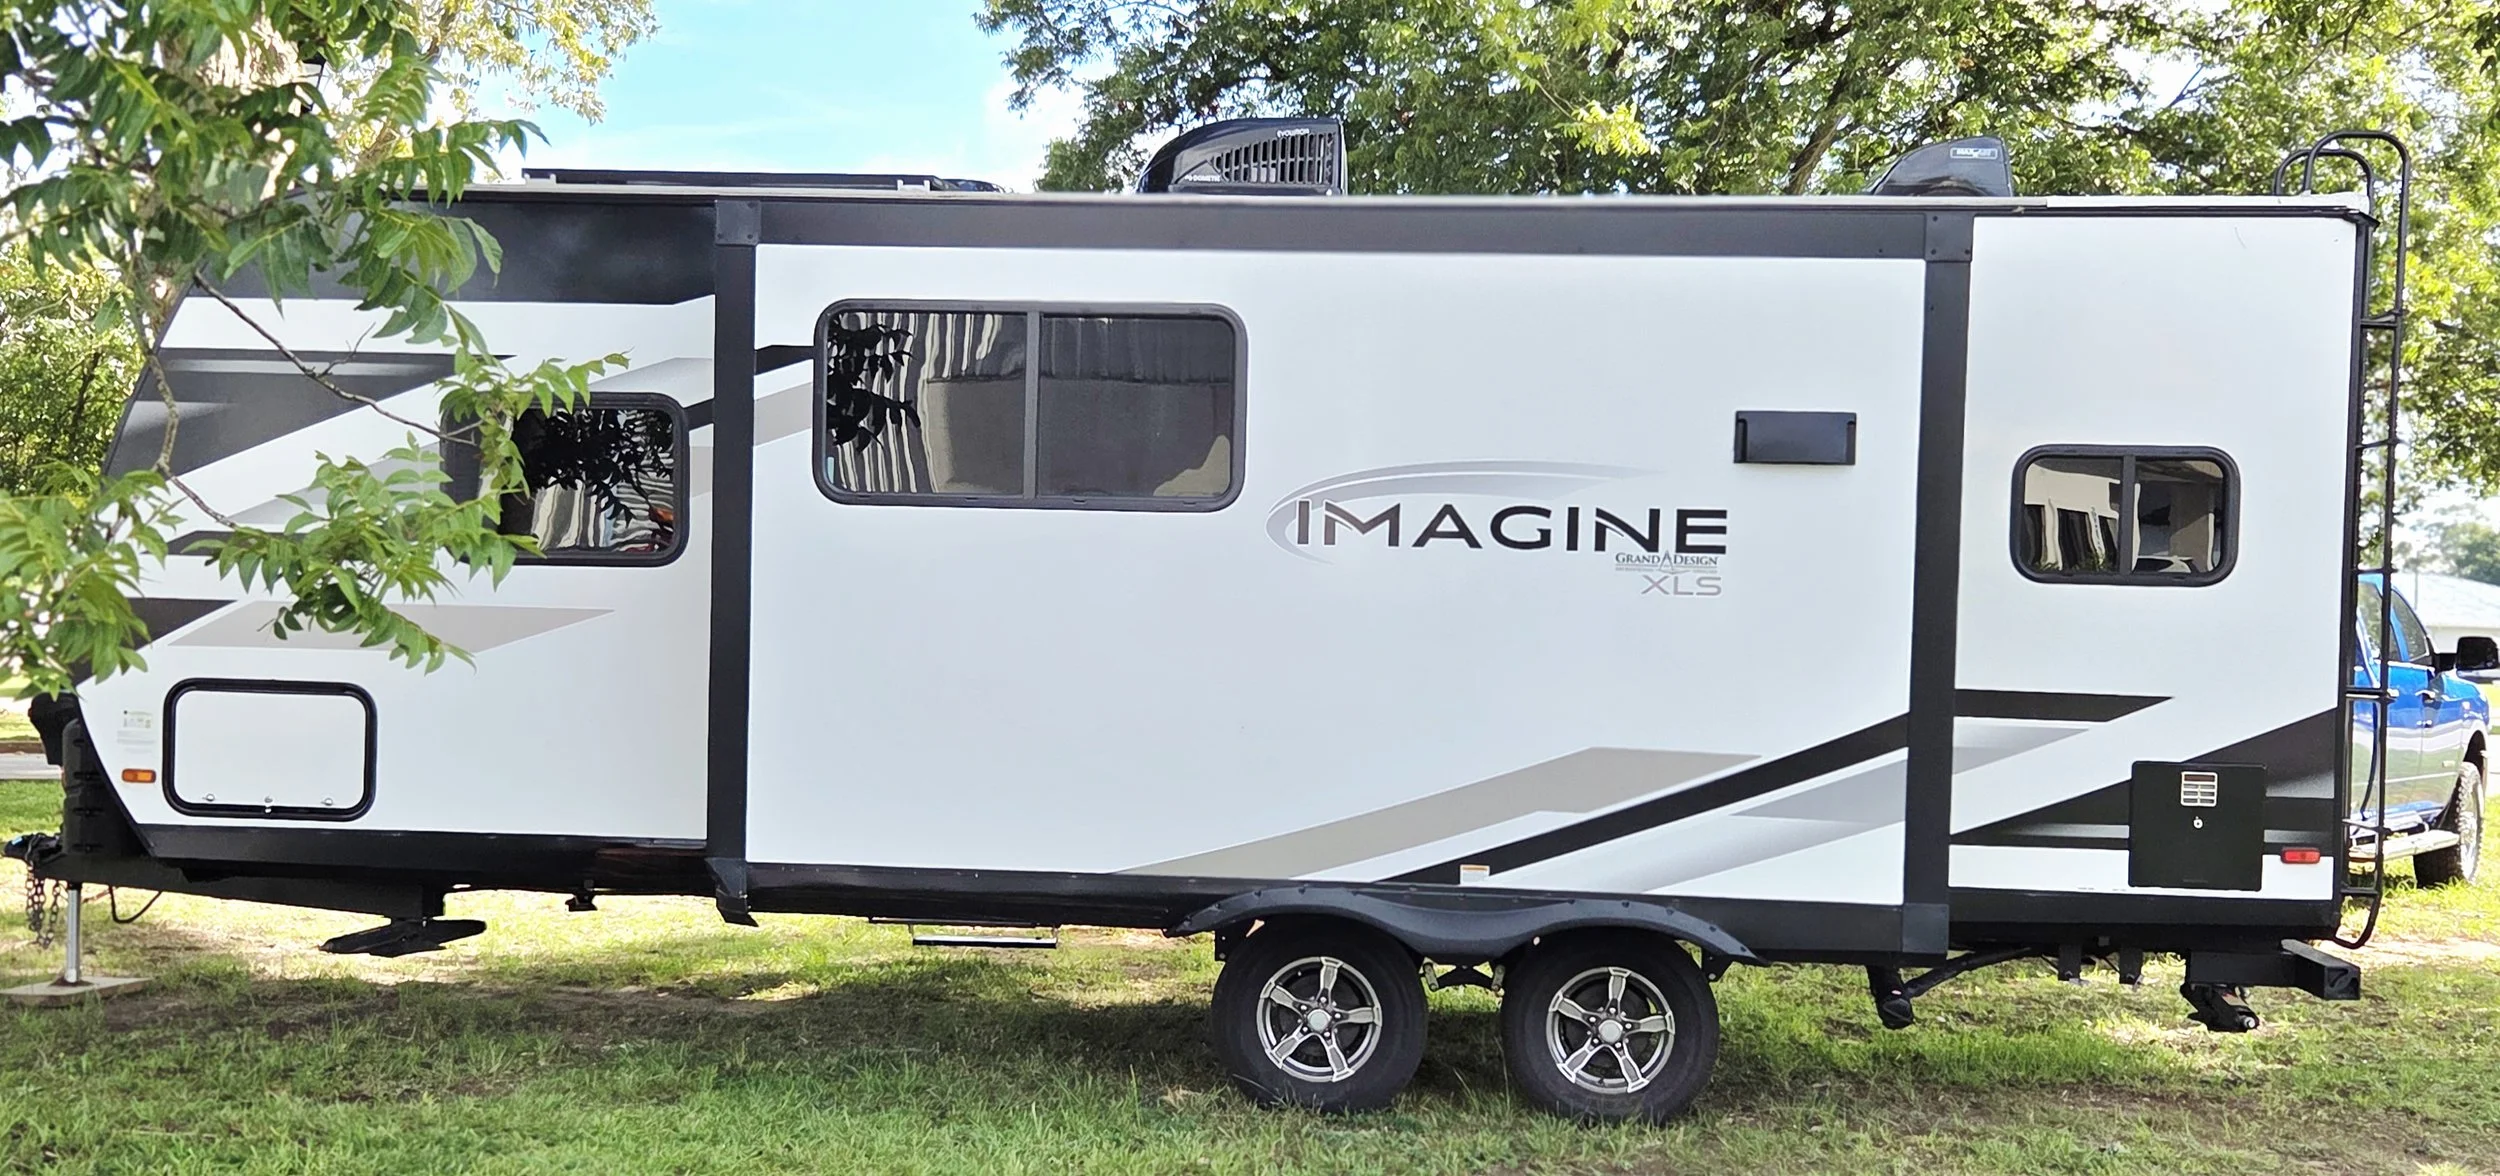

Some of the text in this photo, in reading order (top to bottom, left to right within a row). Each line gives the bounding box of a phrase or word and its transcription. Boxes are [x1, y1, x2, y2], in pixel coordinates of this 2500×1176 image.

[1298, 500, 1728, 555] IMAGINE
[1615, 552, 1718, 566] GRAND DESIGN
[1641, 574, 1722, 596] XLS
